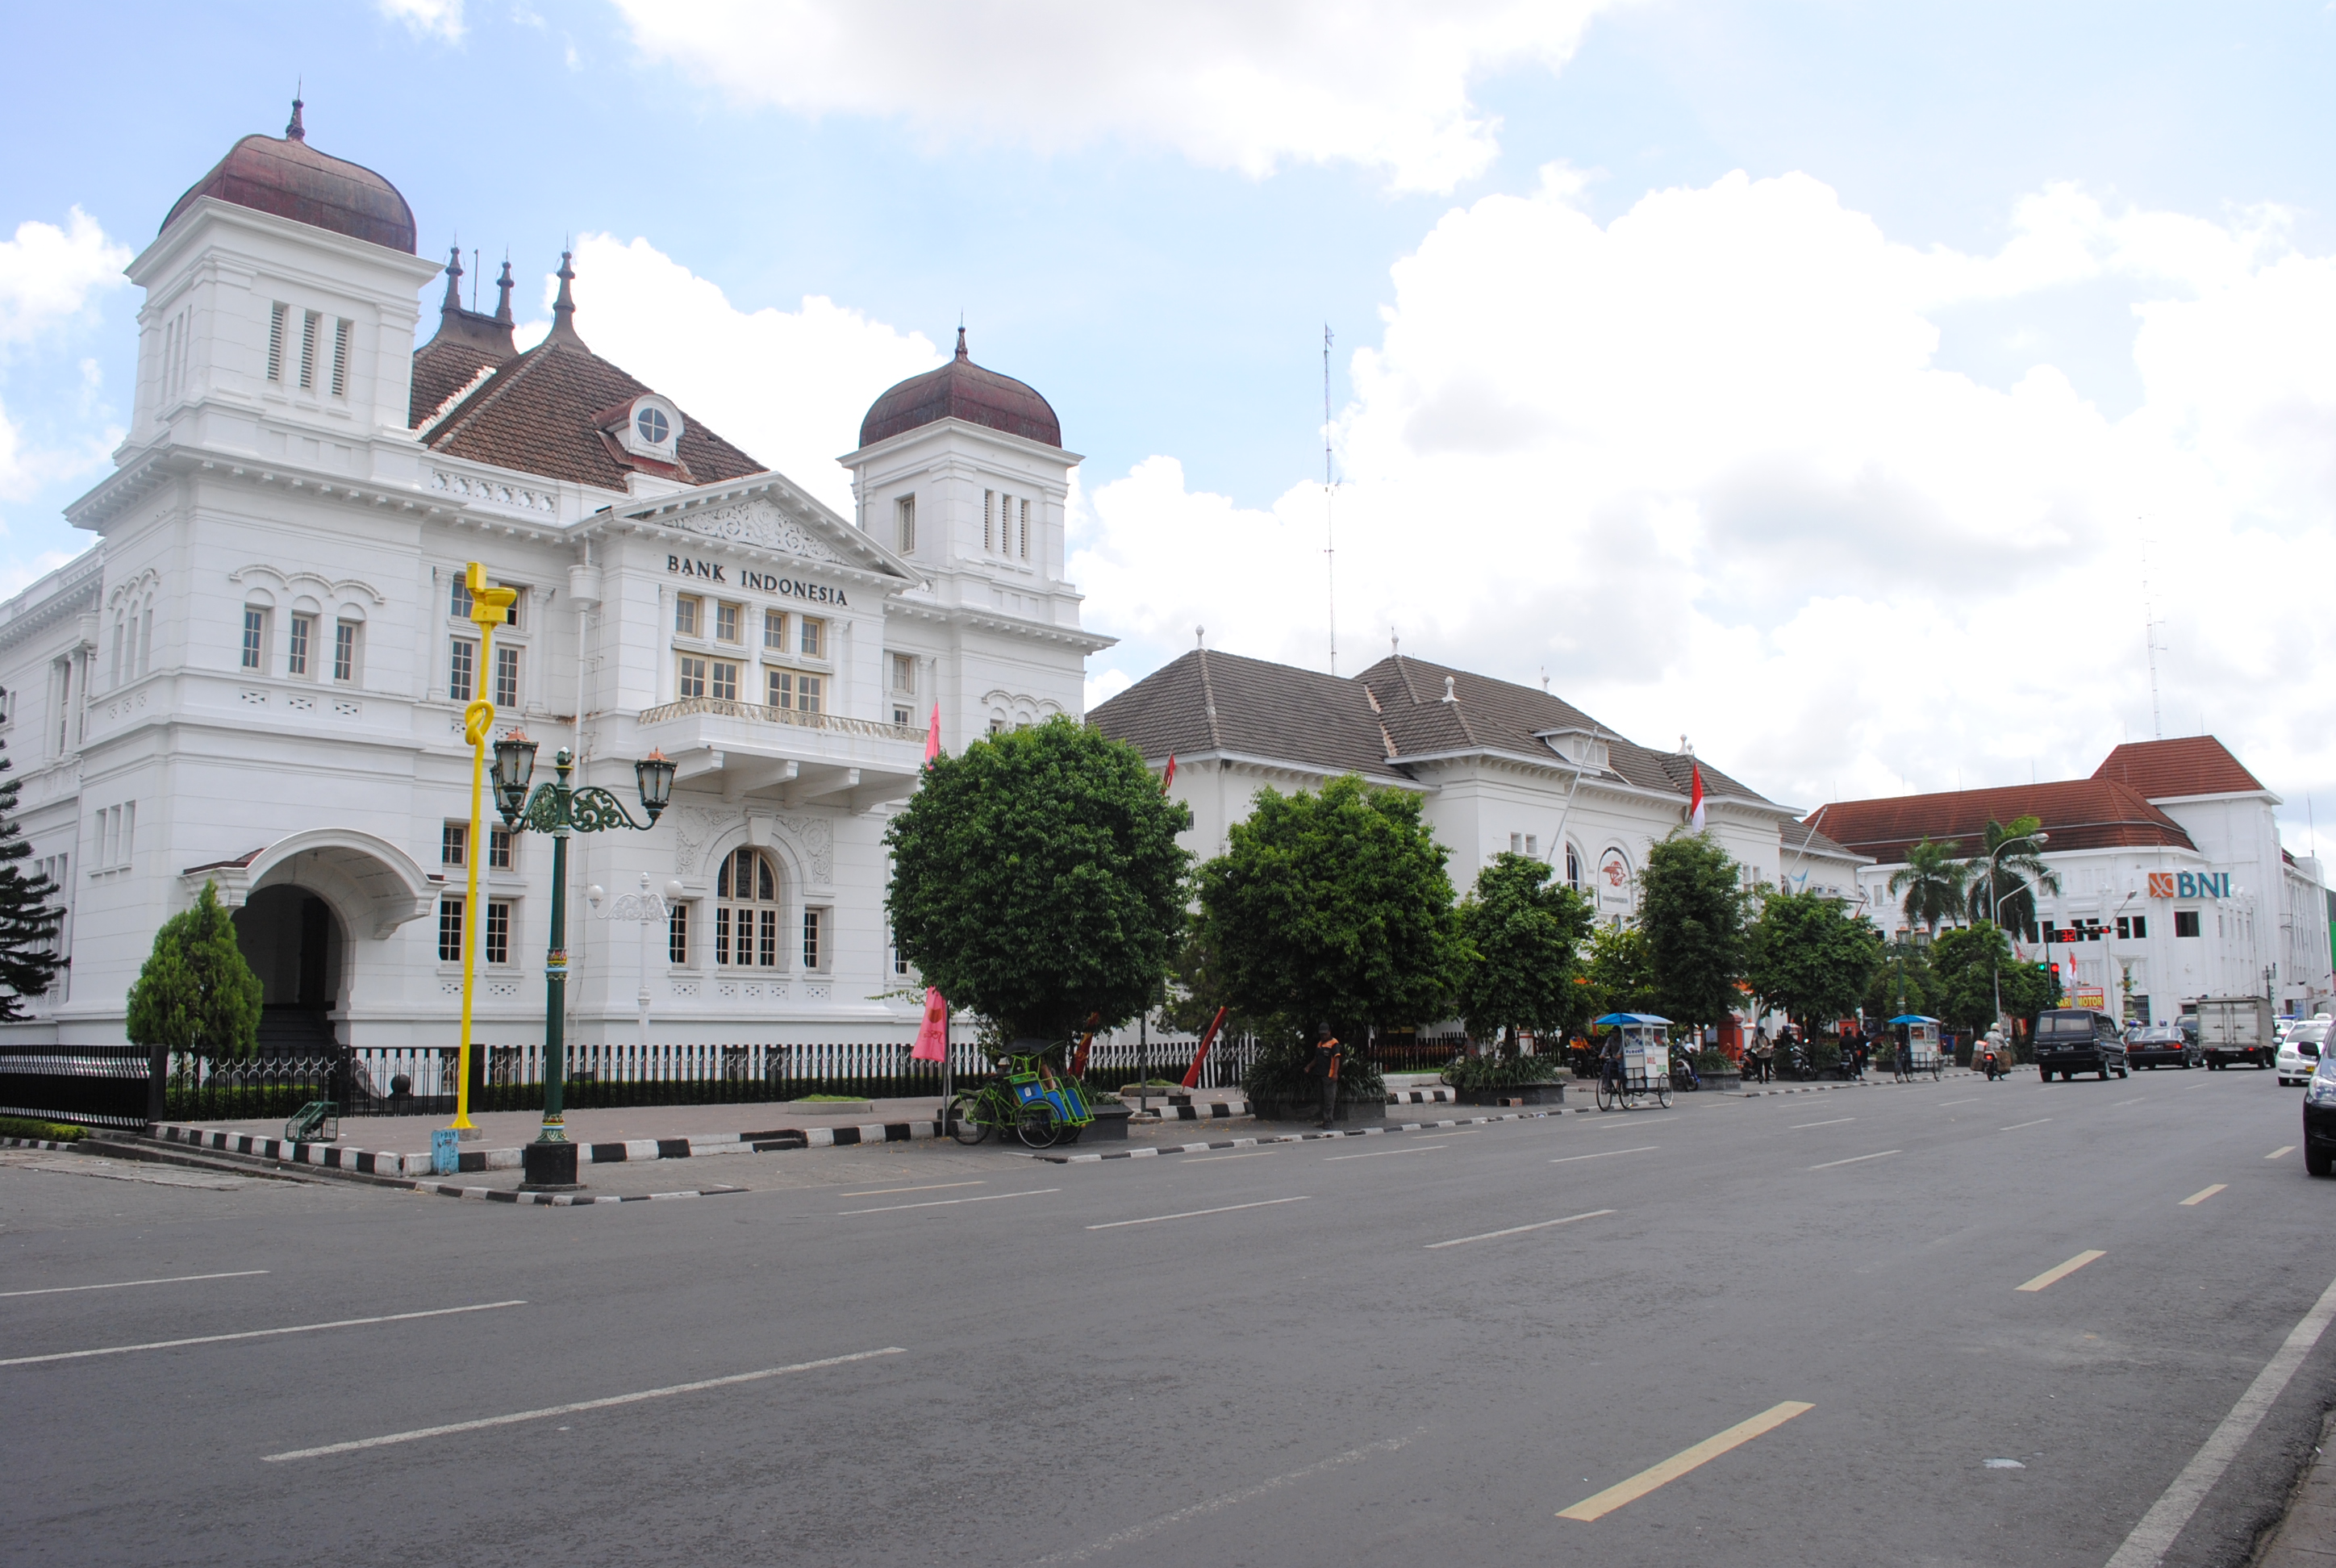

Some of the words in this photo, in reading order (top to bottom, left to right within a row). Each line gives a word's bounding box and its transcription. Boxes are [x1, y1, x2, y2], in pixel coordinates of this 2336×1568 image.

[667, 555, 726, 581] BANK
[740, 570, 848, 606] INDONESIA
[2176, 872, 2230, 898] BNI
[2062, 929, 2075, 942] 32
